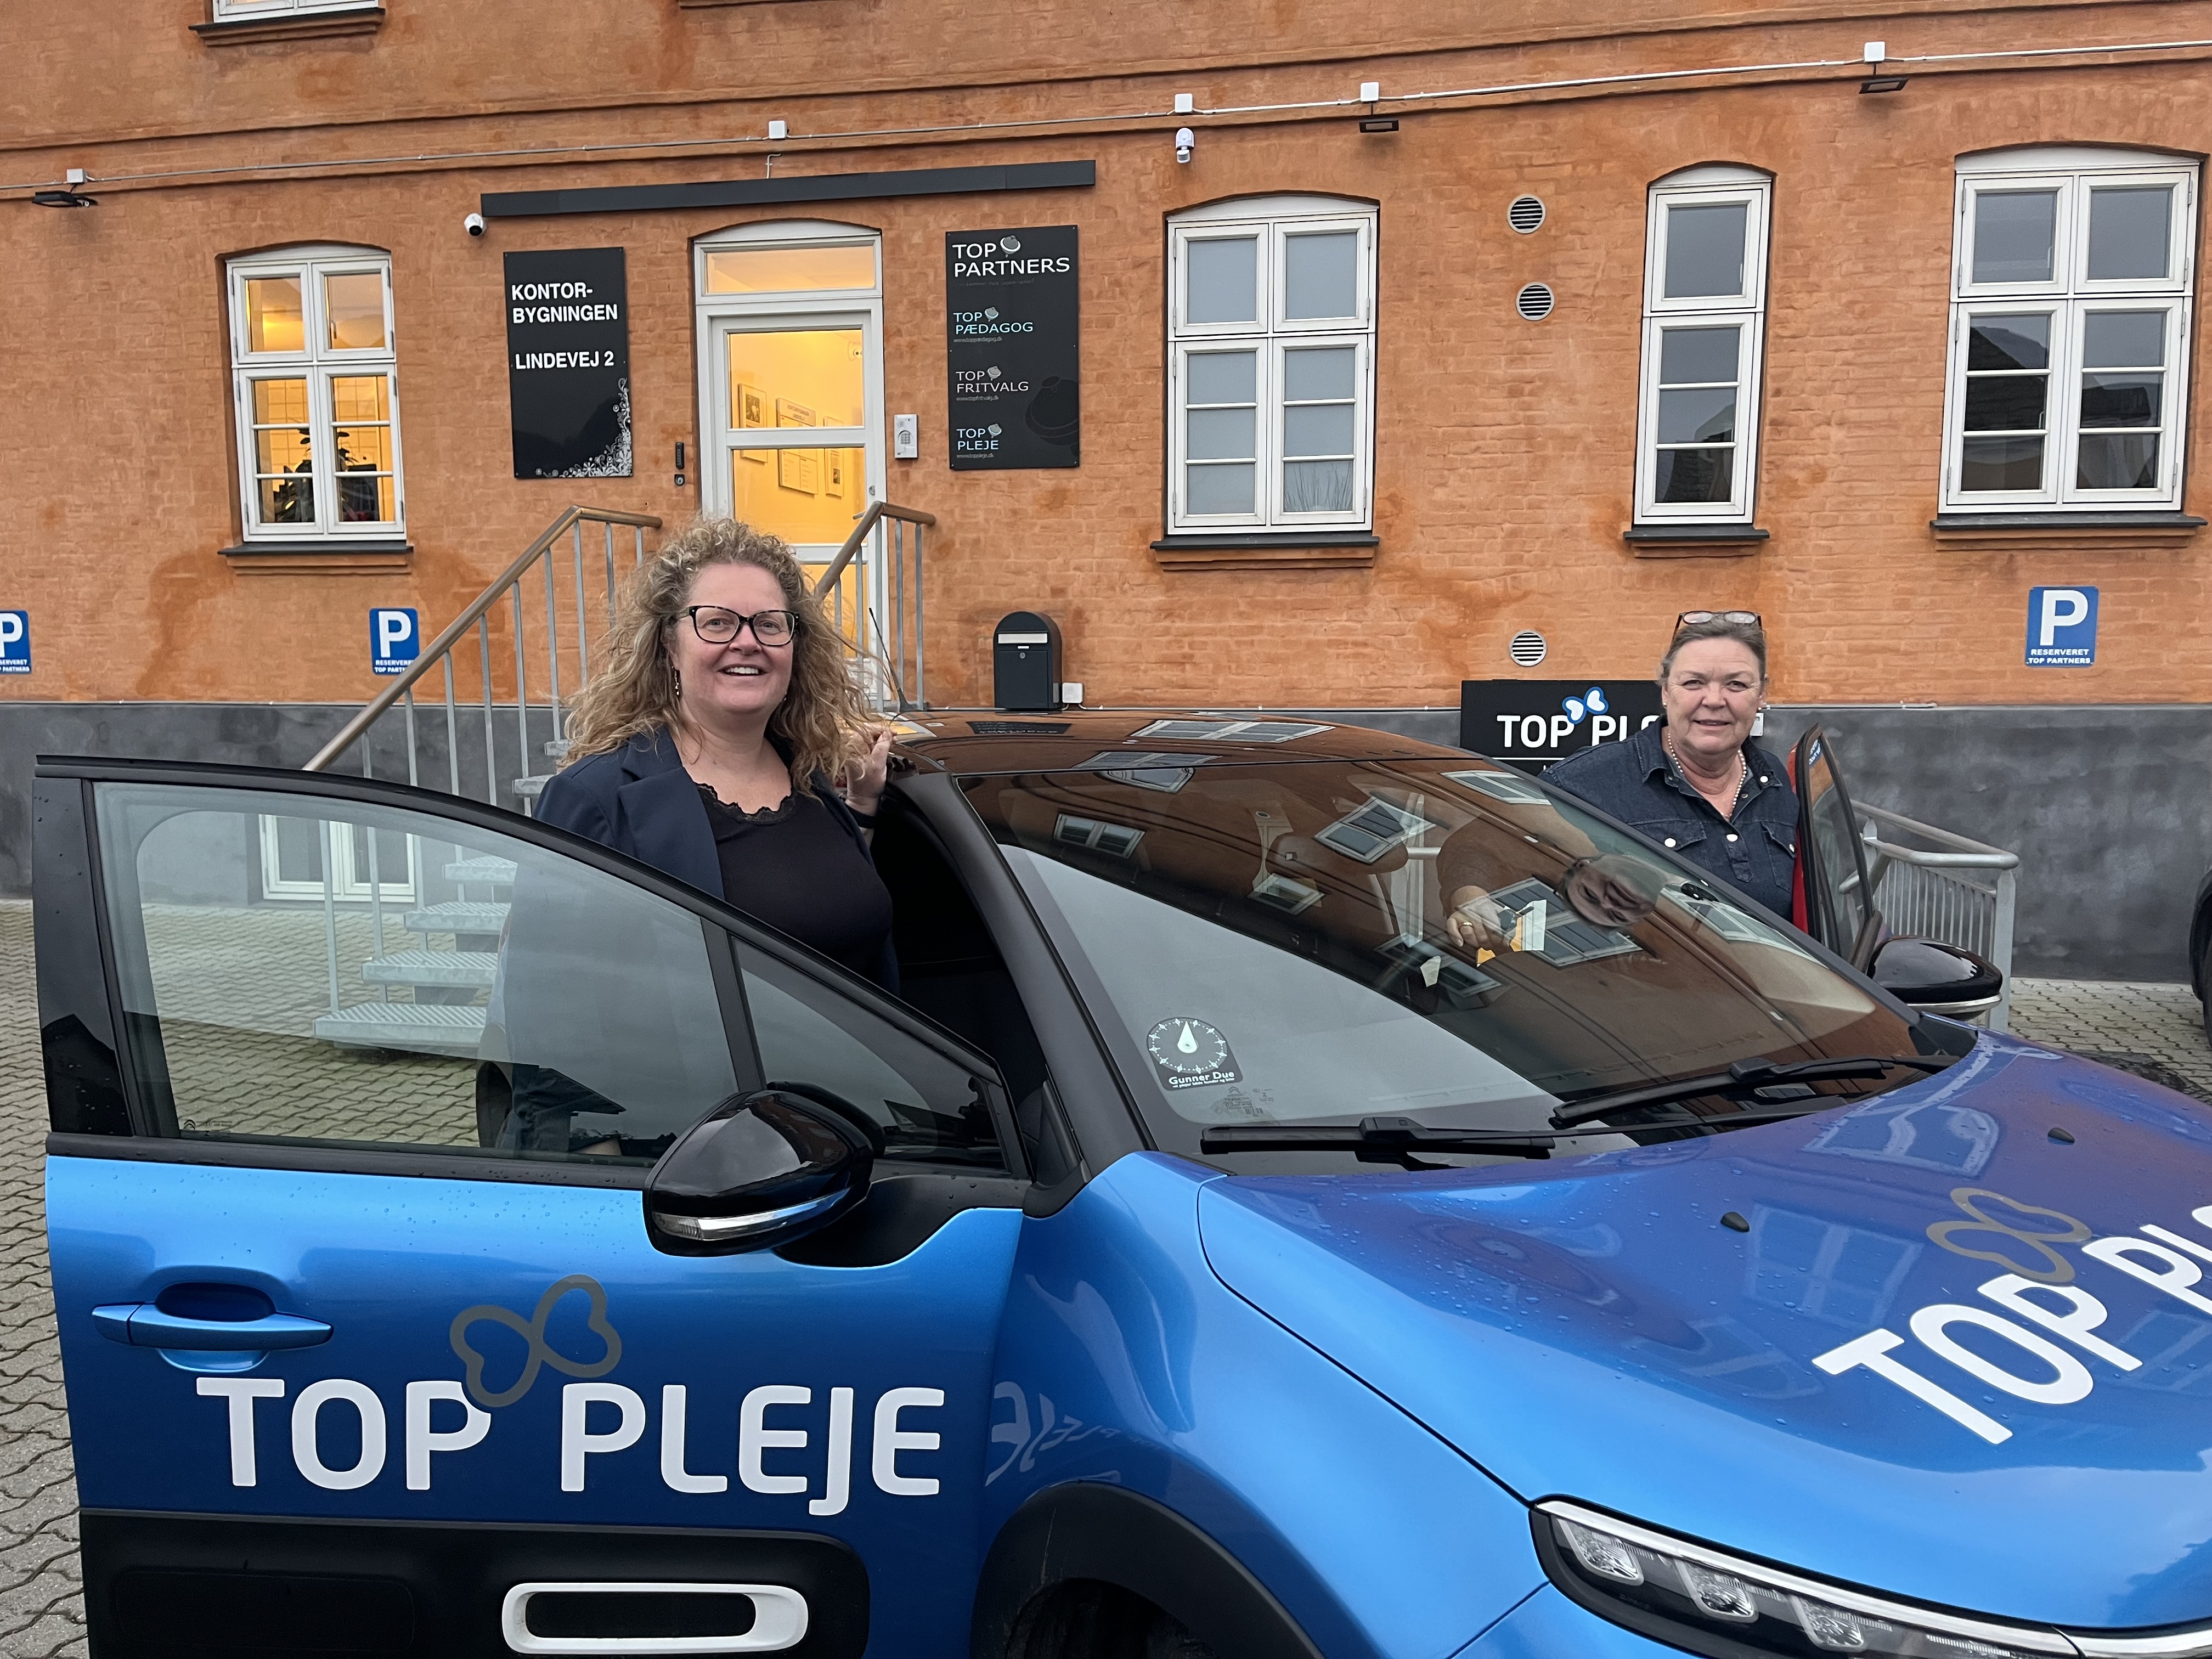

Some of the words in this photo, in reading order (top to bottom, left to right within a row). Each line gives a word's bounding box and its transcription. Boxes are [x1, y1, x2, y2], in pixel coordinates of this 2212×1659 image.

[952, 242, 997, 259] TOP
[955, 257, 1070, 277] PARTNERS
[511, 282, 594, 301] KONTOR-
[512, 304, 618, 324] BYGNINGEN
[952, 312, 983, 323] TOP
[956, 321, 1033, 335] PÆDAGOG
[515, 351, 600, 369] LINDEVEJ
[604, 351, 614, 366] 2
[955, 370, 985, 381] TOP
[957, 381, 1029, 393] FRITVALG
[956, 428, 986, 438] TOP
[957, 440, 999, 450] PLEJE
[2040, 590, 2089, 646] P
[378, 611, 411, 658] P
[1497, 715, 1576, 748] TOP
[1169, 1074, 1210, 1085] Gunner
[1212, 1071, 1234, 1080] Due
[1812, 1273, 2143, 1444] TOP
[196, 1377, 492, 1491] TOP
[560, 1382, 945, 1516] PLEJE
